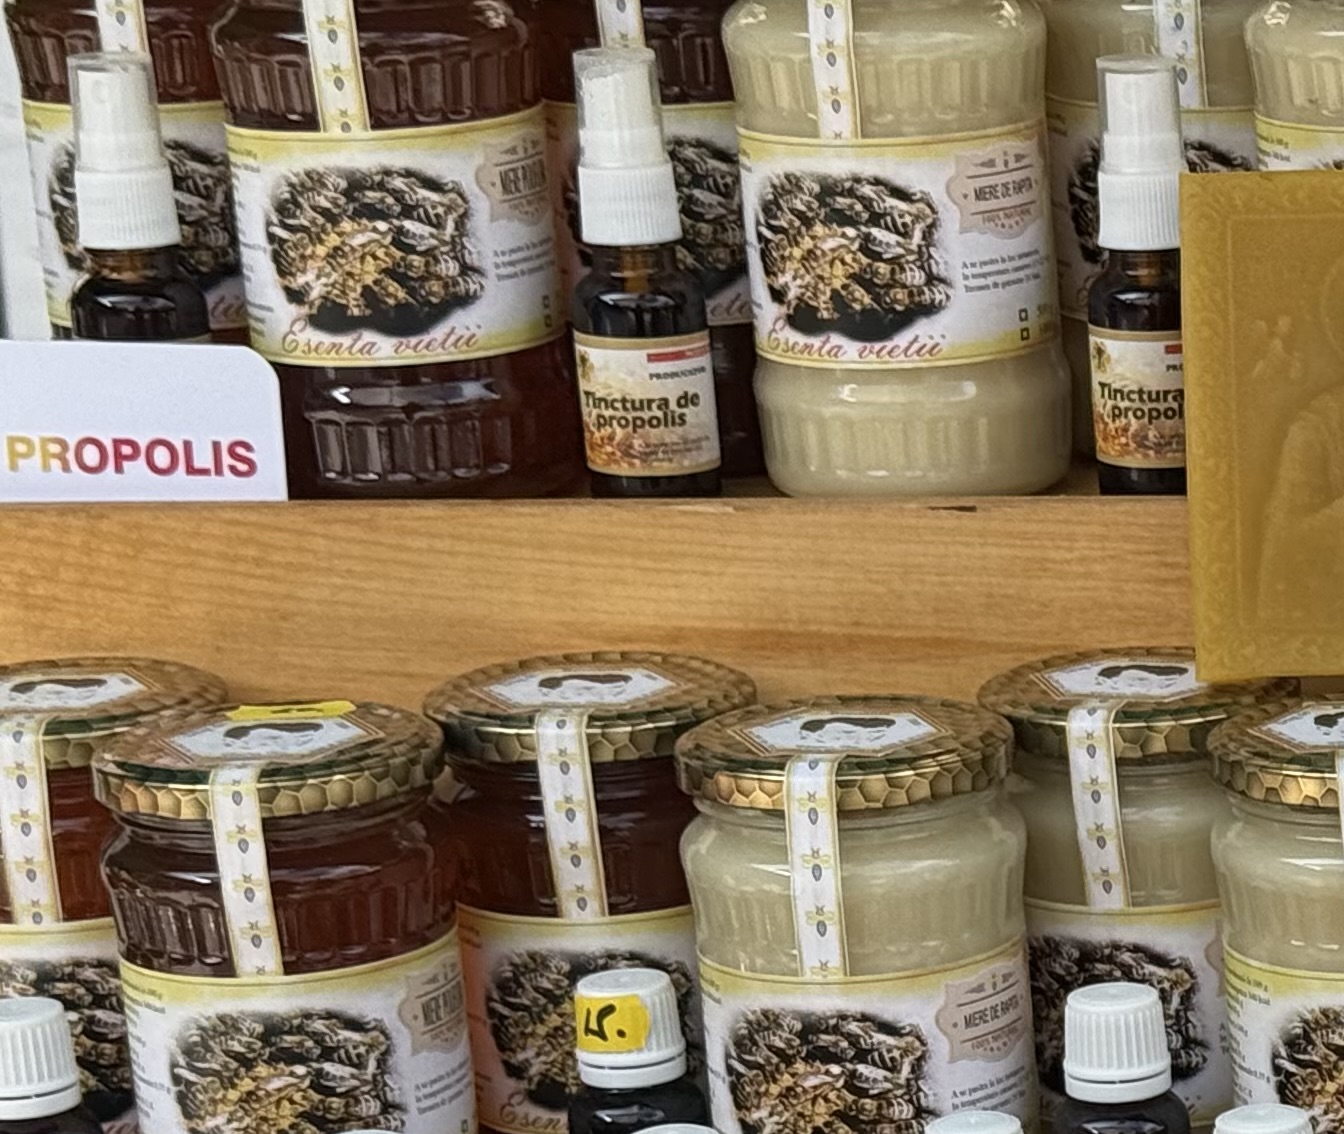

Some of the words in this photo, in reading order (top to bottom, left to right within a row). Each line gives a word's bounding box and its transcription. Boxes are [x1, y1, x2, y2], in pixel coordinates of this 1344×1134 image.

[282, 317, 378, 356] Esenta
[767, 318, 846, 360] Esenta
[584, 390, 670, 412] Tinctura
[676, 391, 700, 409] de
[1111, 402, 1183, 423] propol
[596, 410, 688, 433] propolis
[6, 435, 258, 478] PROPOLIS
[500, 1092, 563, 1127] Esen
